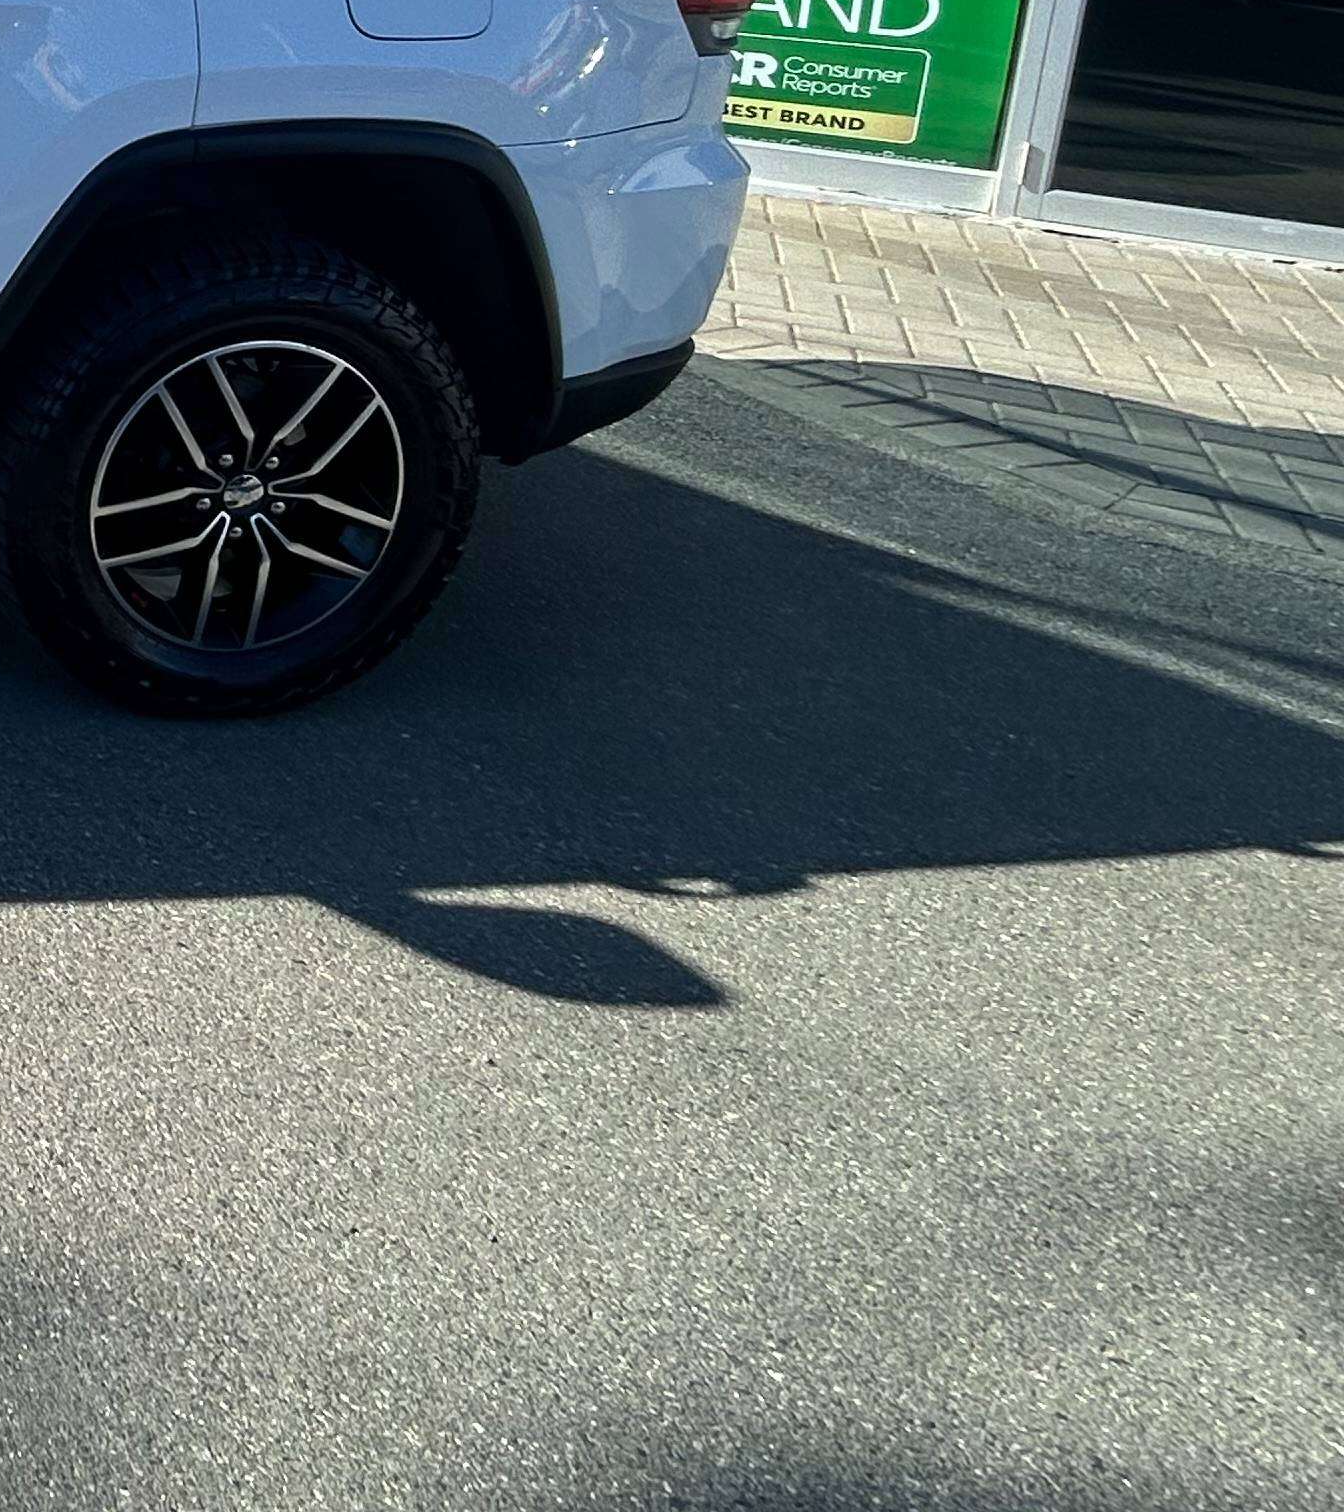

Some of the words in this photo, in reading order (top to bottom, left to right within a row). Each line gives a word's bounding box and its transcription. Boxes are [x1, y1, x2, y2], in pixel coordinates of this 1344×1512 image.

[783, 55, 908, 84] Consumer
[782, 73, 872, 99] Reports
[779, 109, 866, 131] BRAND
